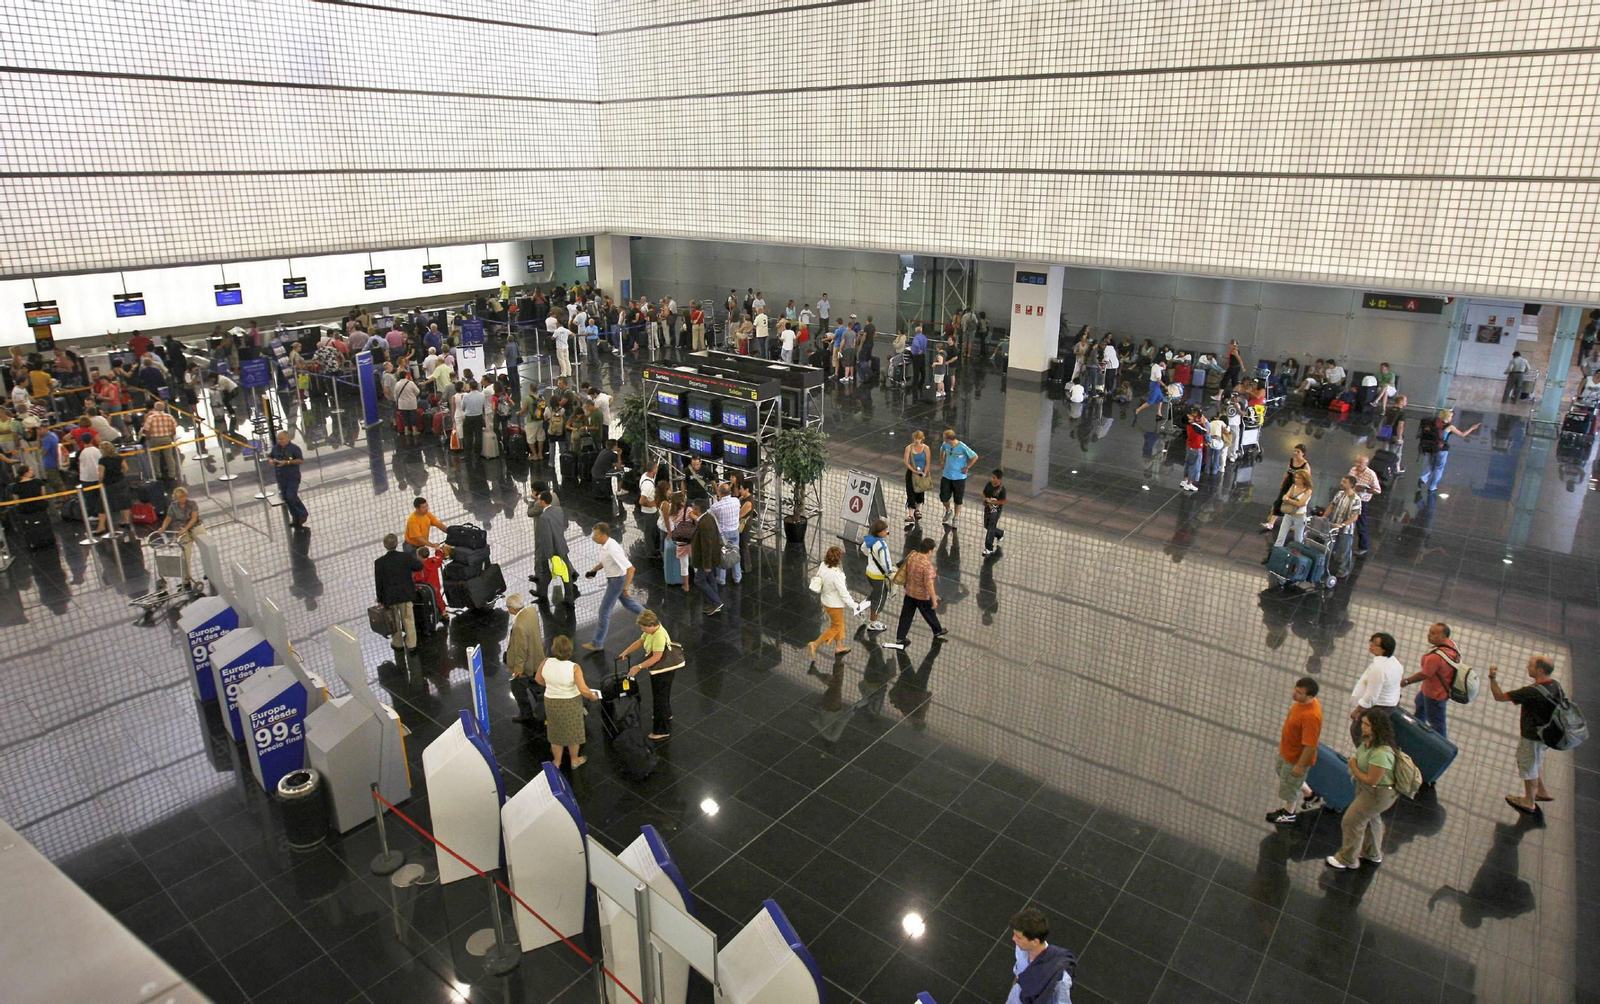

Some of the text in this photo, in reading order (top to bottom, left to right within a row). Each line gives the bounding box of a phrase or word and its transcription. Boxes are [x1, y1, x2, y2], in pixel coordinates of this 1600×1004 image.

[1407, 301, 1415, 310] A
[851, 497, 860, 511] A
[188, 624, 221, 639] Europa
[192, 641, 215, 663] 9
[221, 661, 256, 677] Europa
[250, 703, 286, 722] Europa
[268, 707, 298, 726] desde
[258, 733, 303, 757] precio final
